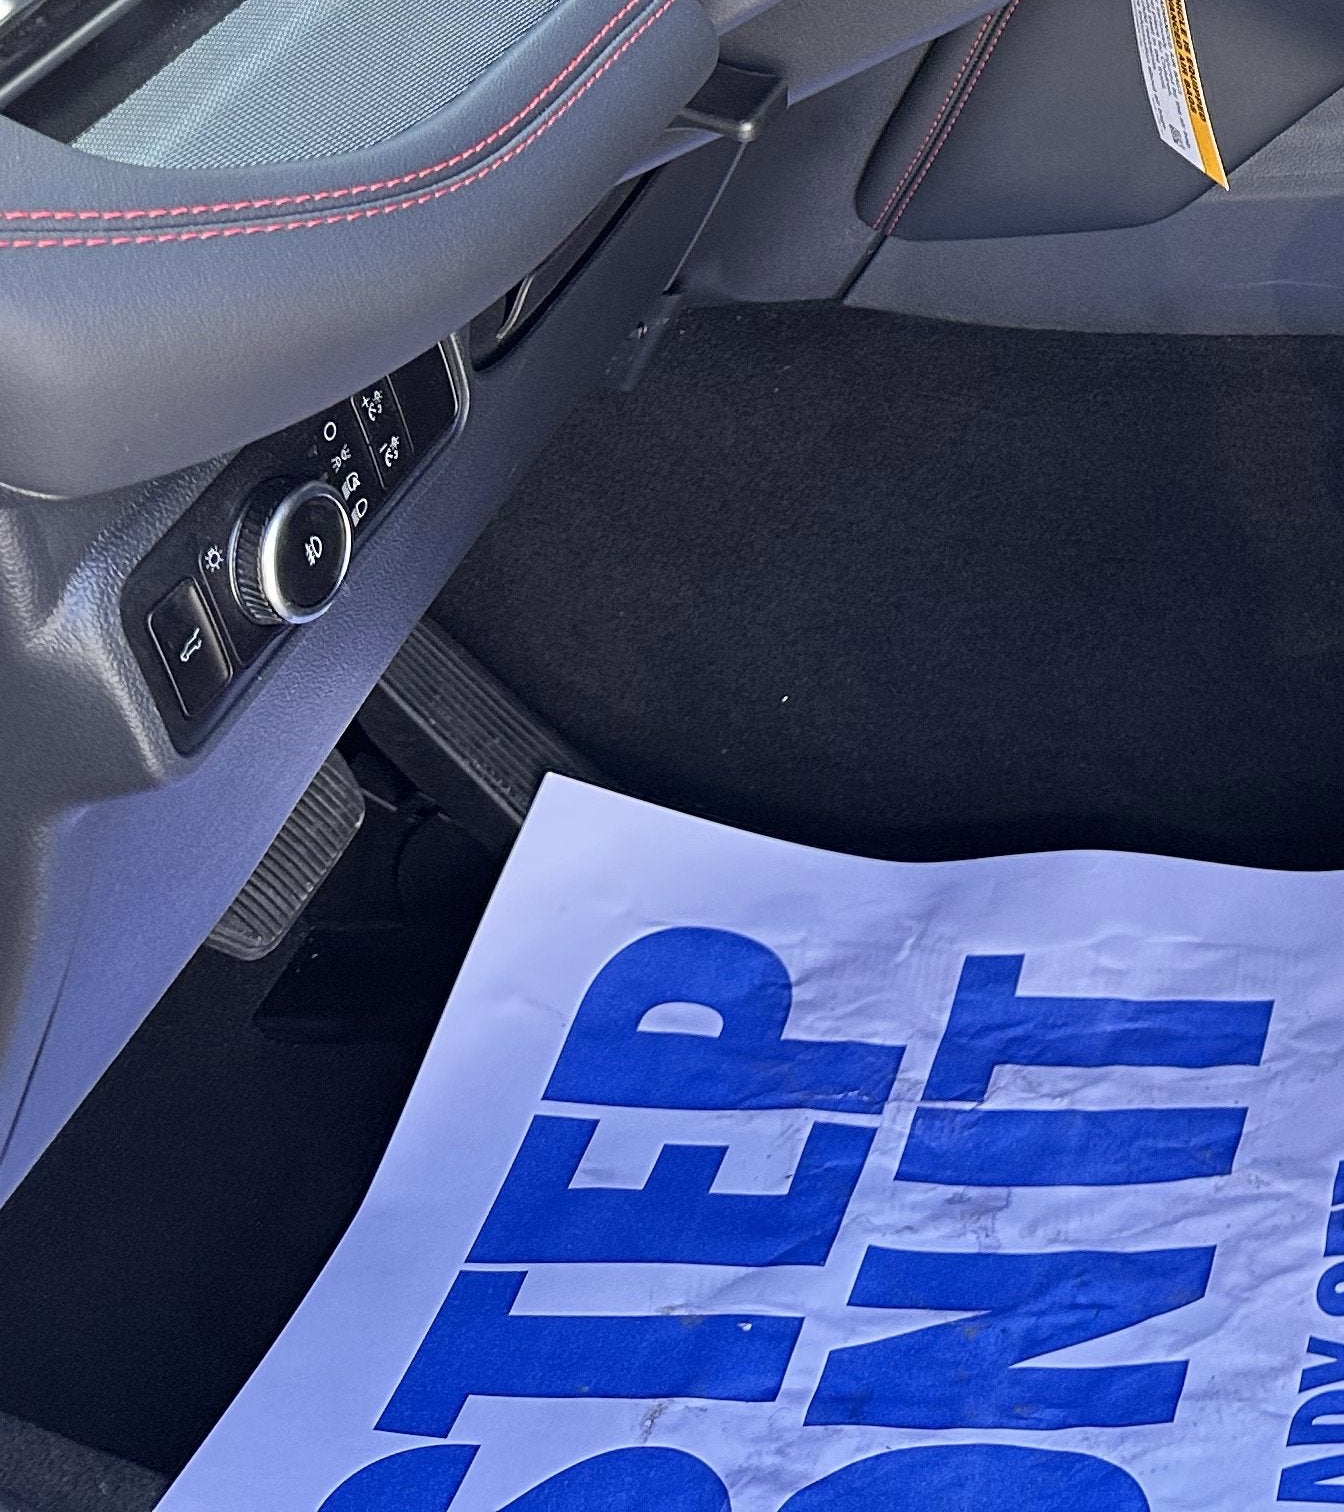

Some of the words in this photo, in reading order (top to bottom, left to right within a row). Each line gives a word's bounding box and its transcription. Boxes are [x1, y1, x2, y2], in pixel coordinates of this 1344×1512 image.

[1182, 39, 1191, 54] IS
[1179, 51, 1188, 76] AIR
[1184, 79, 1197, 114] BAGS
[1186, 56, 1206, 122] EQUIPPED
[893, 954, 1276, 1187] IT
